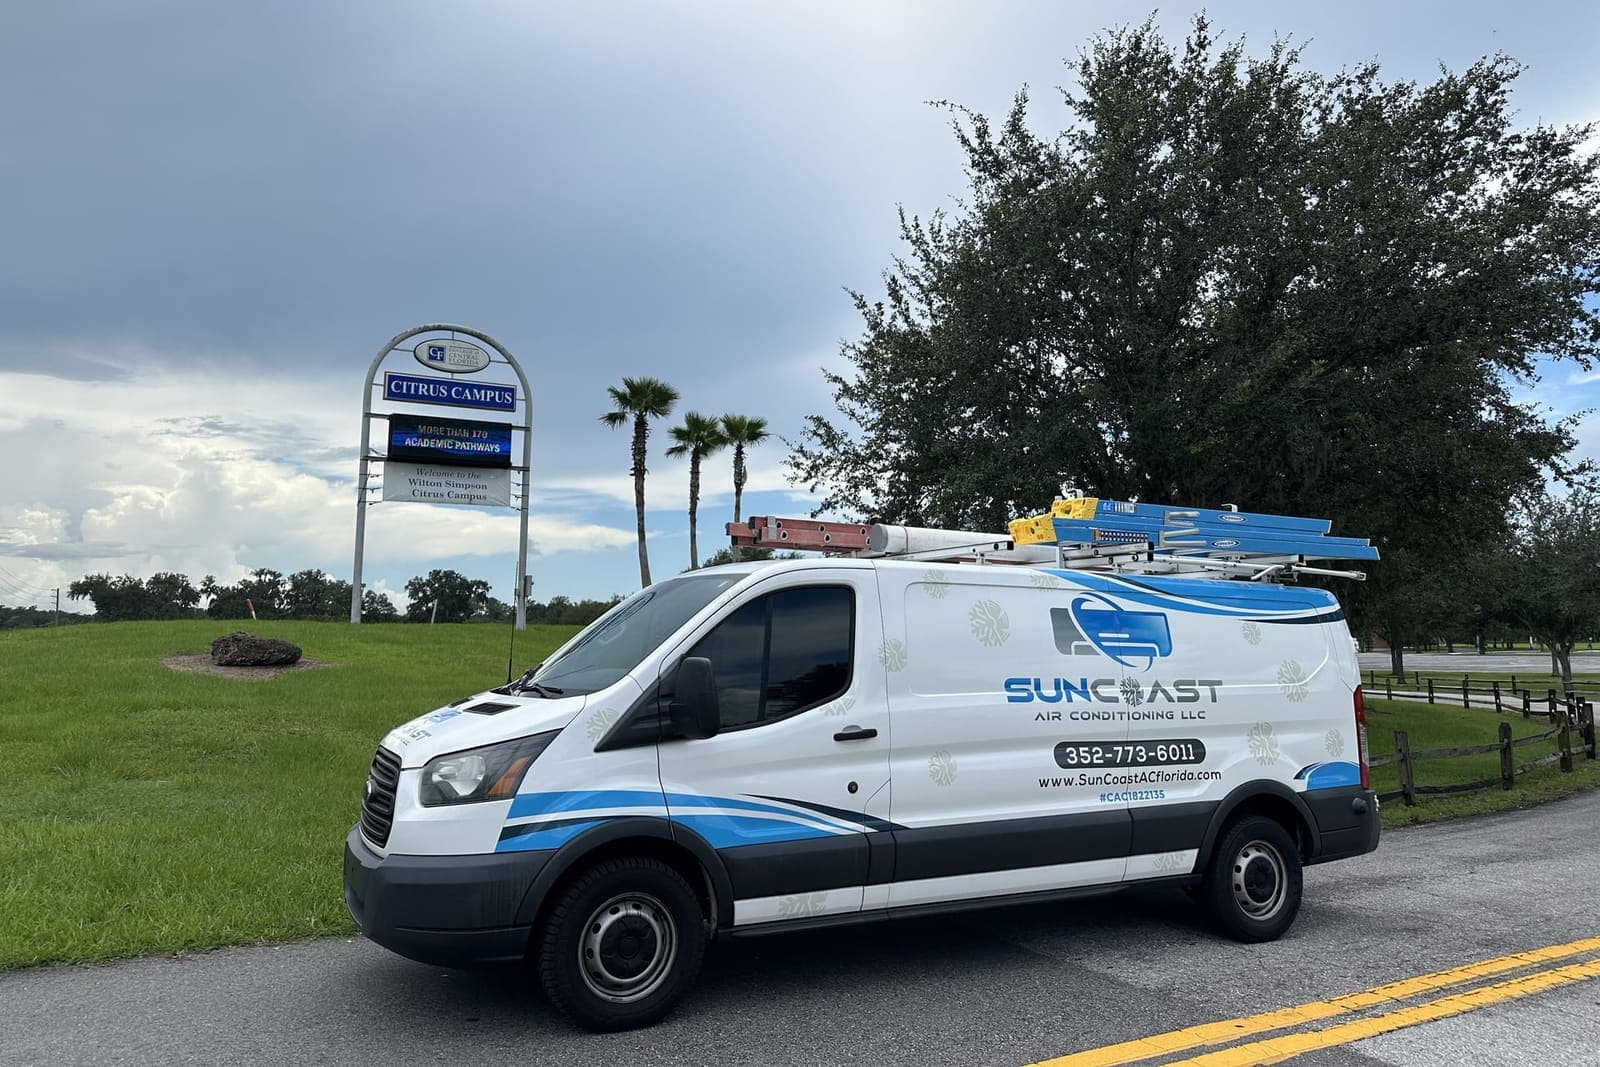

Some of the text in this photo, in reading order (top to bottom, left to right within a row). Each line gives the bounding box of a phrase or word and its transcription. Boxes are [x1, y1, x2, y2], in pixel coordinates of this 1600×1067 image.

[390, 380, 512, 404] CITRUS CAMPUS
[418, 425, 445, 436] MORE
[446, 427, 469, 438] THAN
[404, 437, 500, 453] ACADEMIC PATHWAYS
[416, 468, 455, 478] Welcome
[467, 472, 480, 480] the
[408, 478, 488, 490] Wilton Simpson
[412, 488, 487, 501] Citrus Campus
[1034, 710, 1206, 721] AIR CONDITIONING LLC
[1065, 744, 1195, 765] 352-773-6011
[1038, 769, 1222, 788] www.SunCoastACflorida.com
[1100, 789, 1165, 803] #CAC1822135
